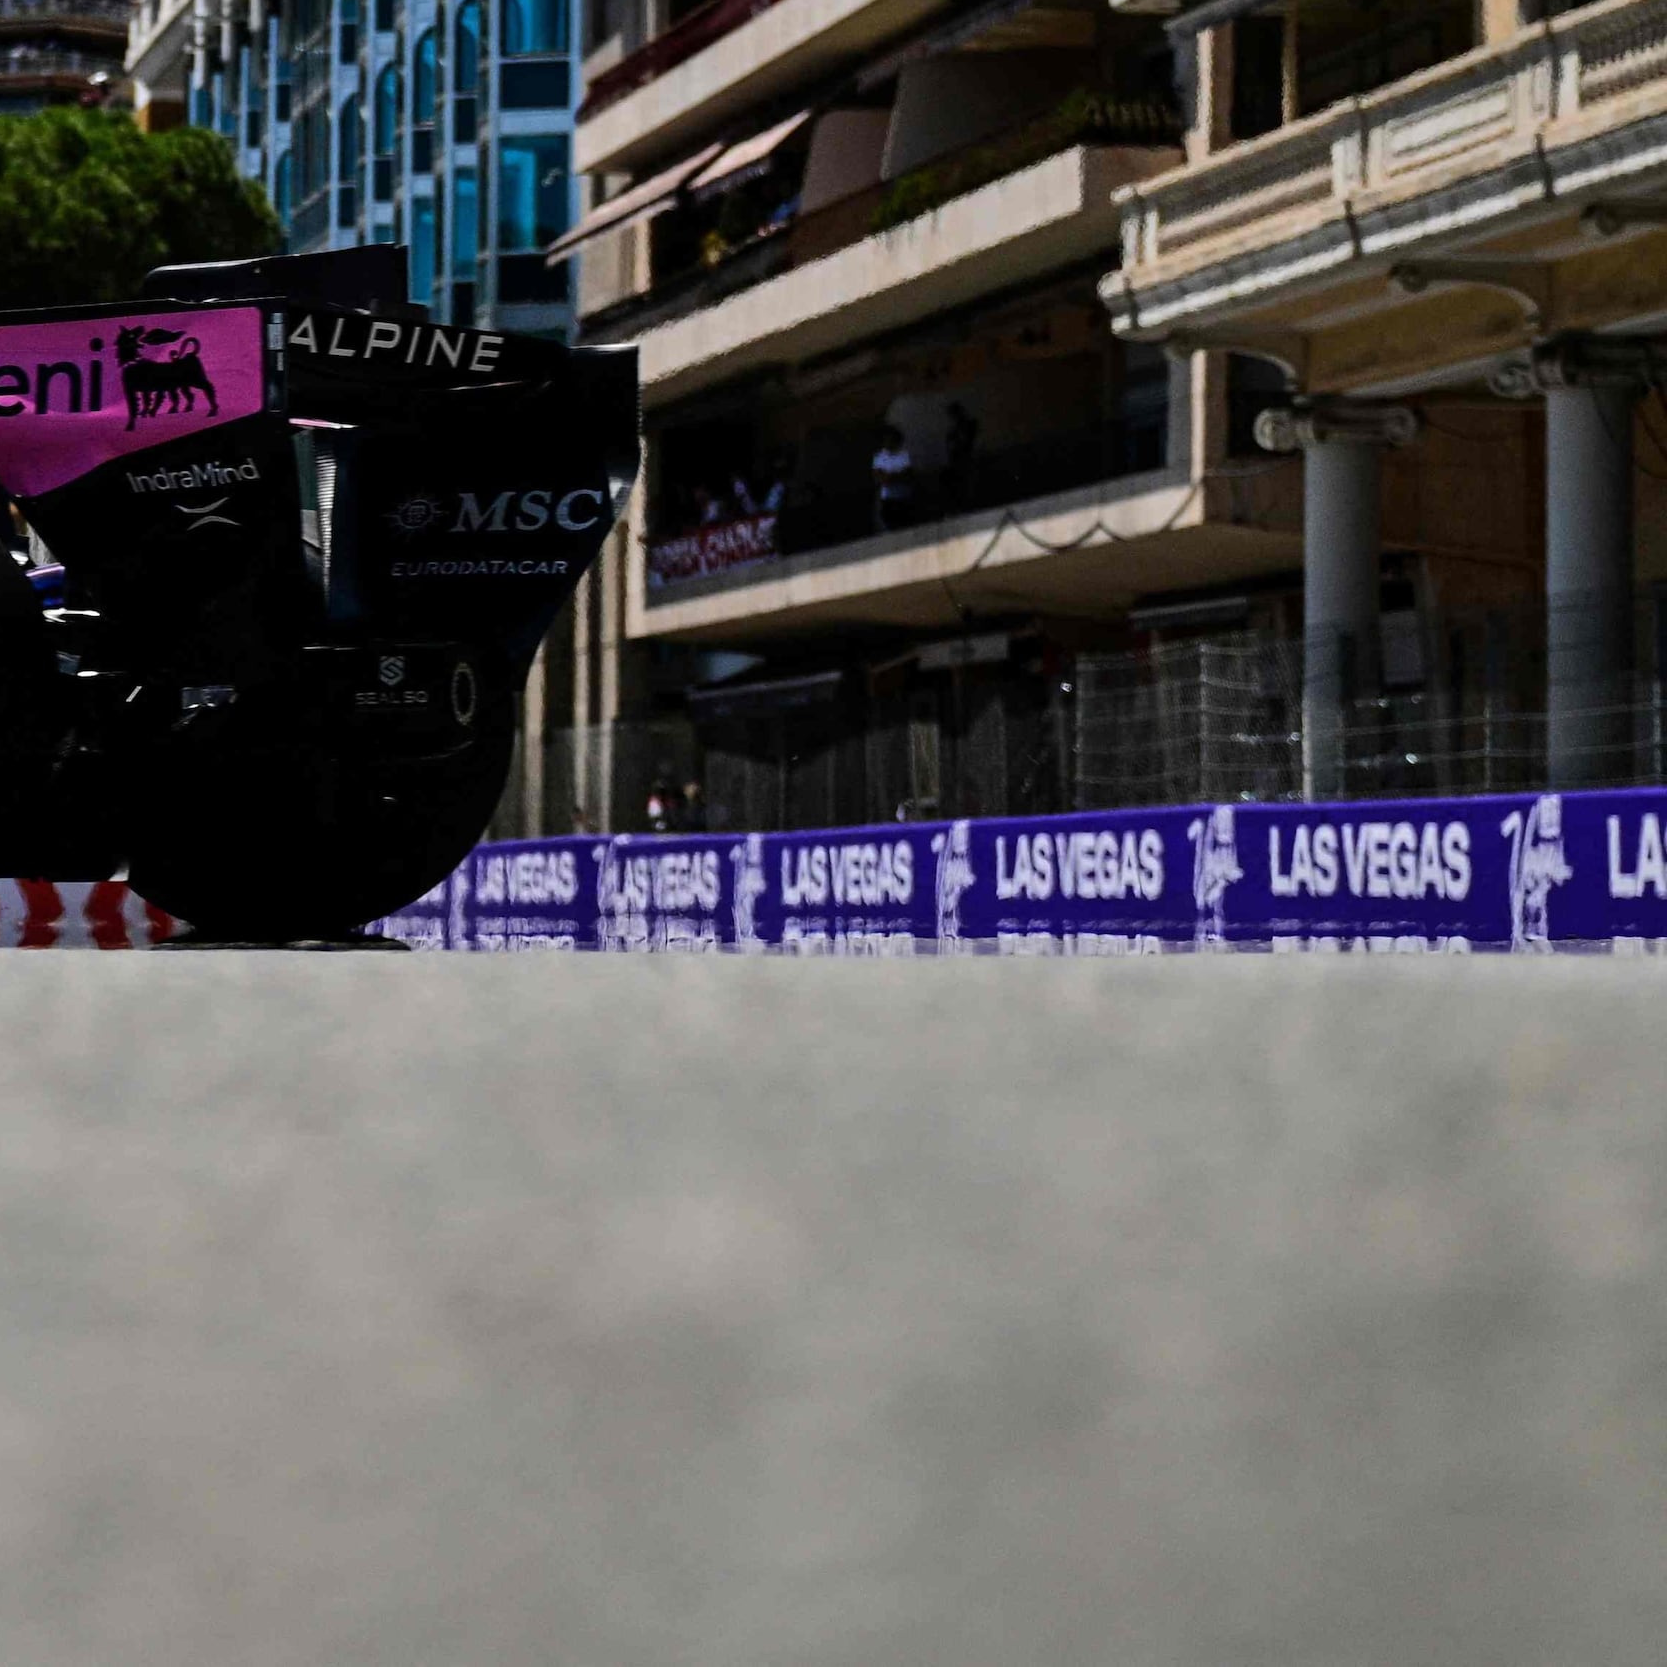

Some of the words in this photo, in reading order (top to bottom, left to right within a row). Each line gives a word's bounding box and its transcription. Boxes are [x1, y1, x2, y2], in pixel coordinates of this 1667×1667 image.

[288, 314, 505, 372] ALPINE
[127, 457, 260, 494] IndraMind
[449, 489, 604, 532] MSC
[390, 560, 568, 577] EURODATACAR
[781, 846, 828, 907] LAS
[829, 839, 914, 907] VEGAS
[995, 833, 1054, 901] LAS
[1056, 828, 1164, 901] VEGAS
[1269, 824, 1339, 898] LAS
[1341, 820, 1472, 902] VEGAS
